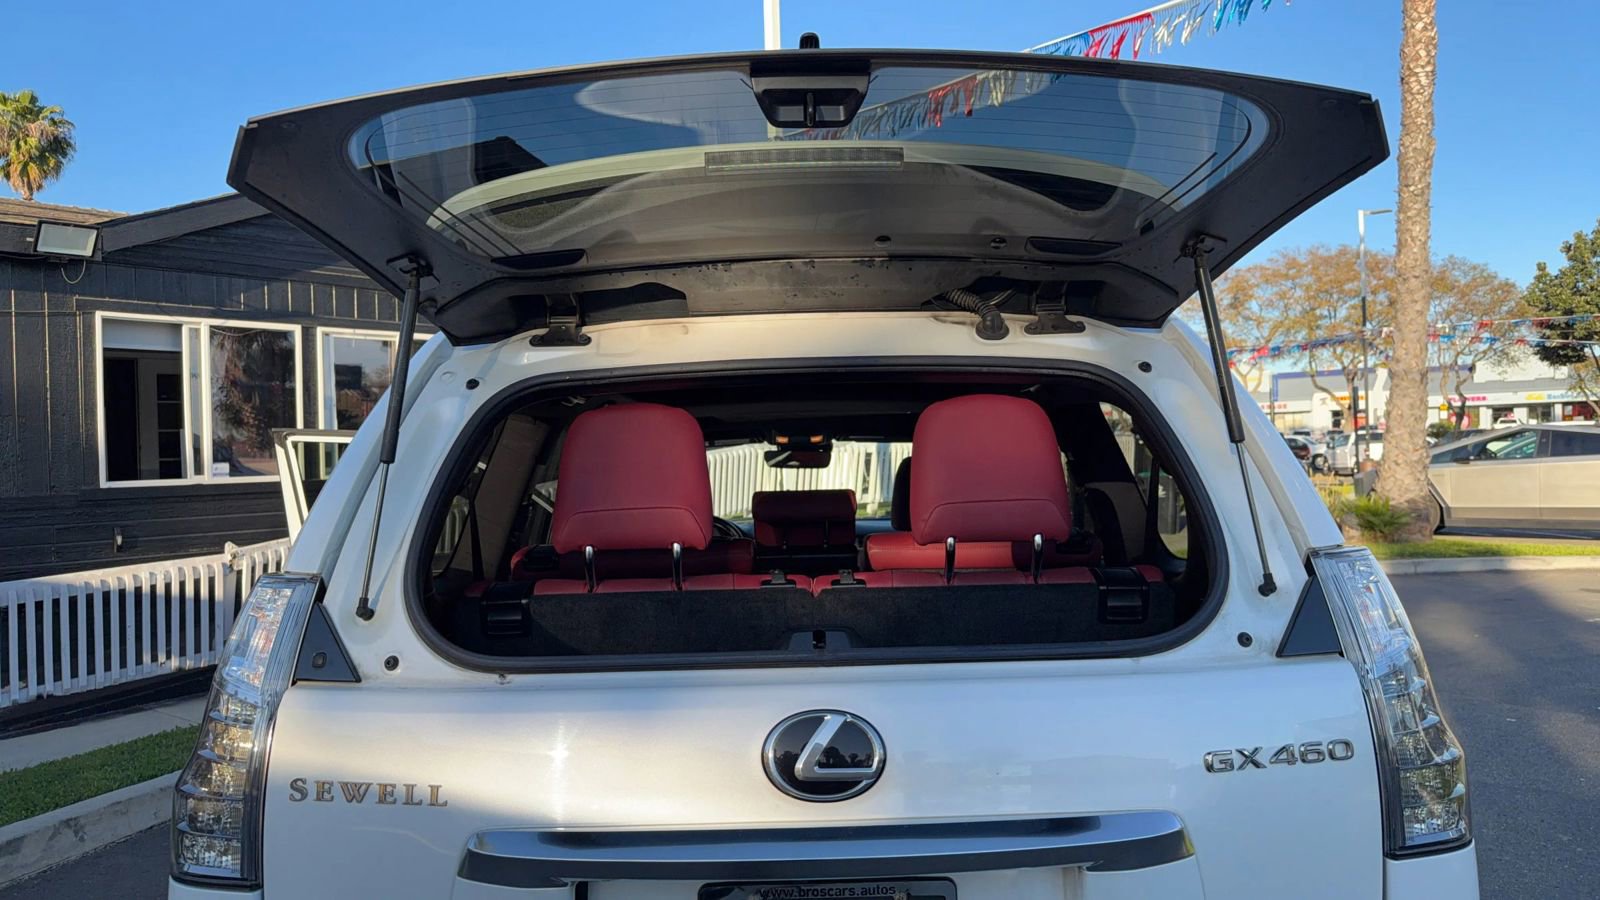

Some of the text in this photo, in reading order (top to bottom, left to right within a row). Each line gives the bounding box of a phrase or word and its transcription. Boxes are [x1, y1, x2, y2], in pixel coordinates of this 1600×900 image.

[1203, 738, 1355, 774] GX460
[288, 777, 449, 807] SEWELL
[758, 883, 897, 899] www.broscars.autos
